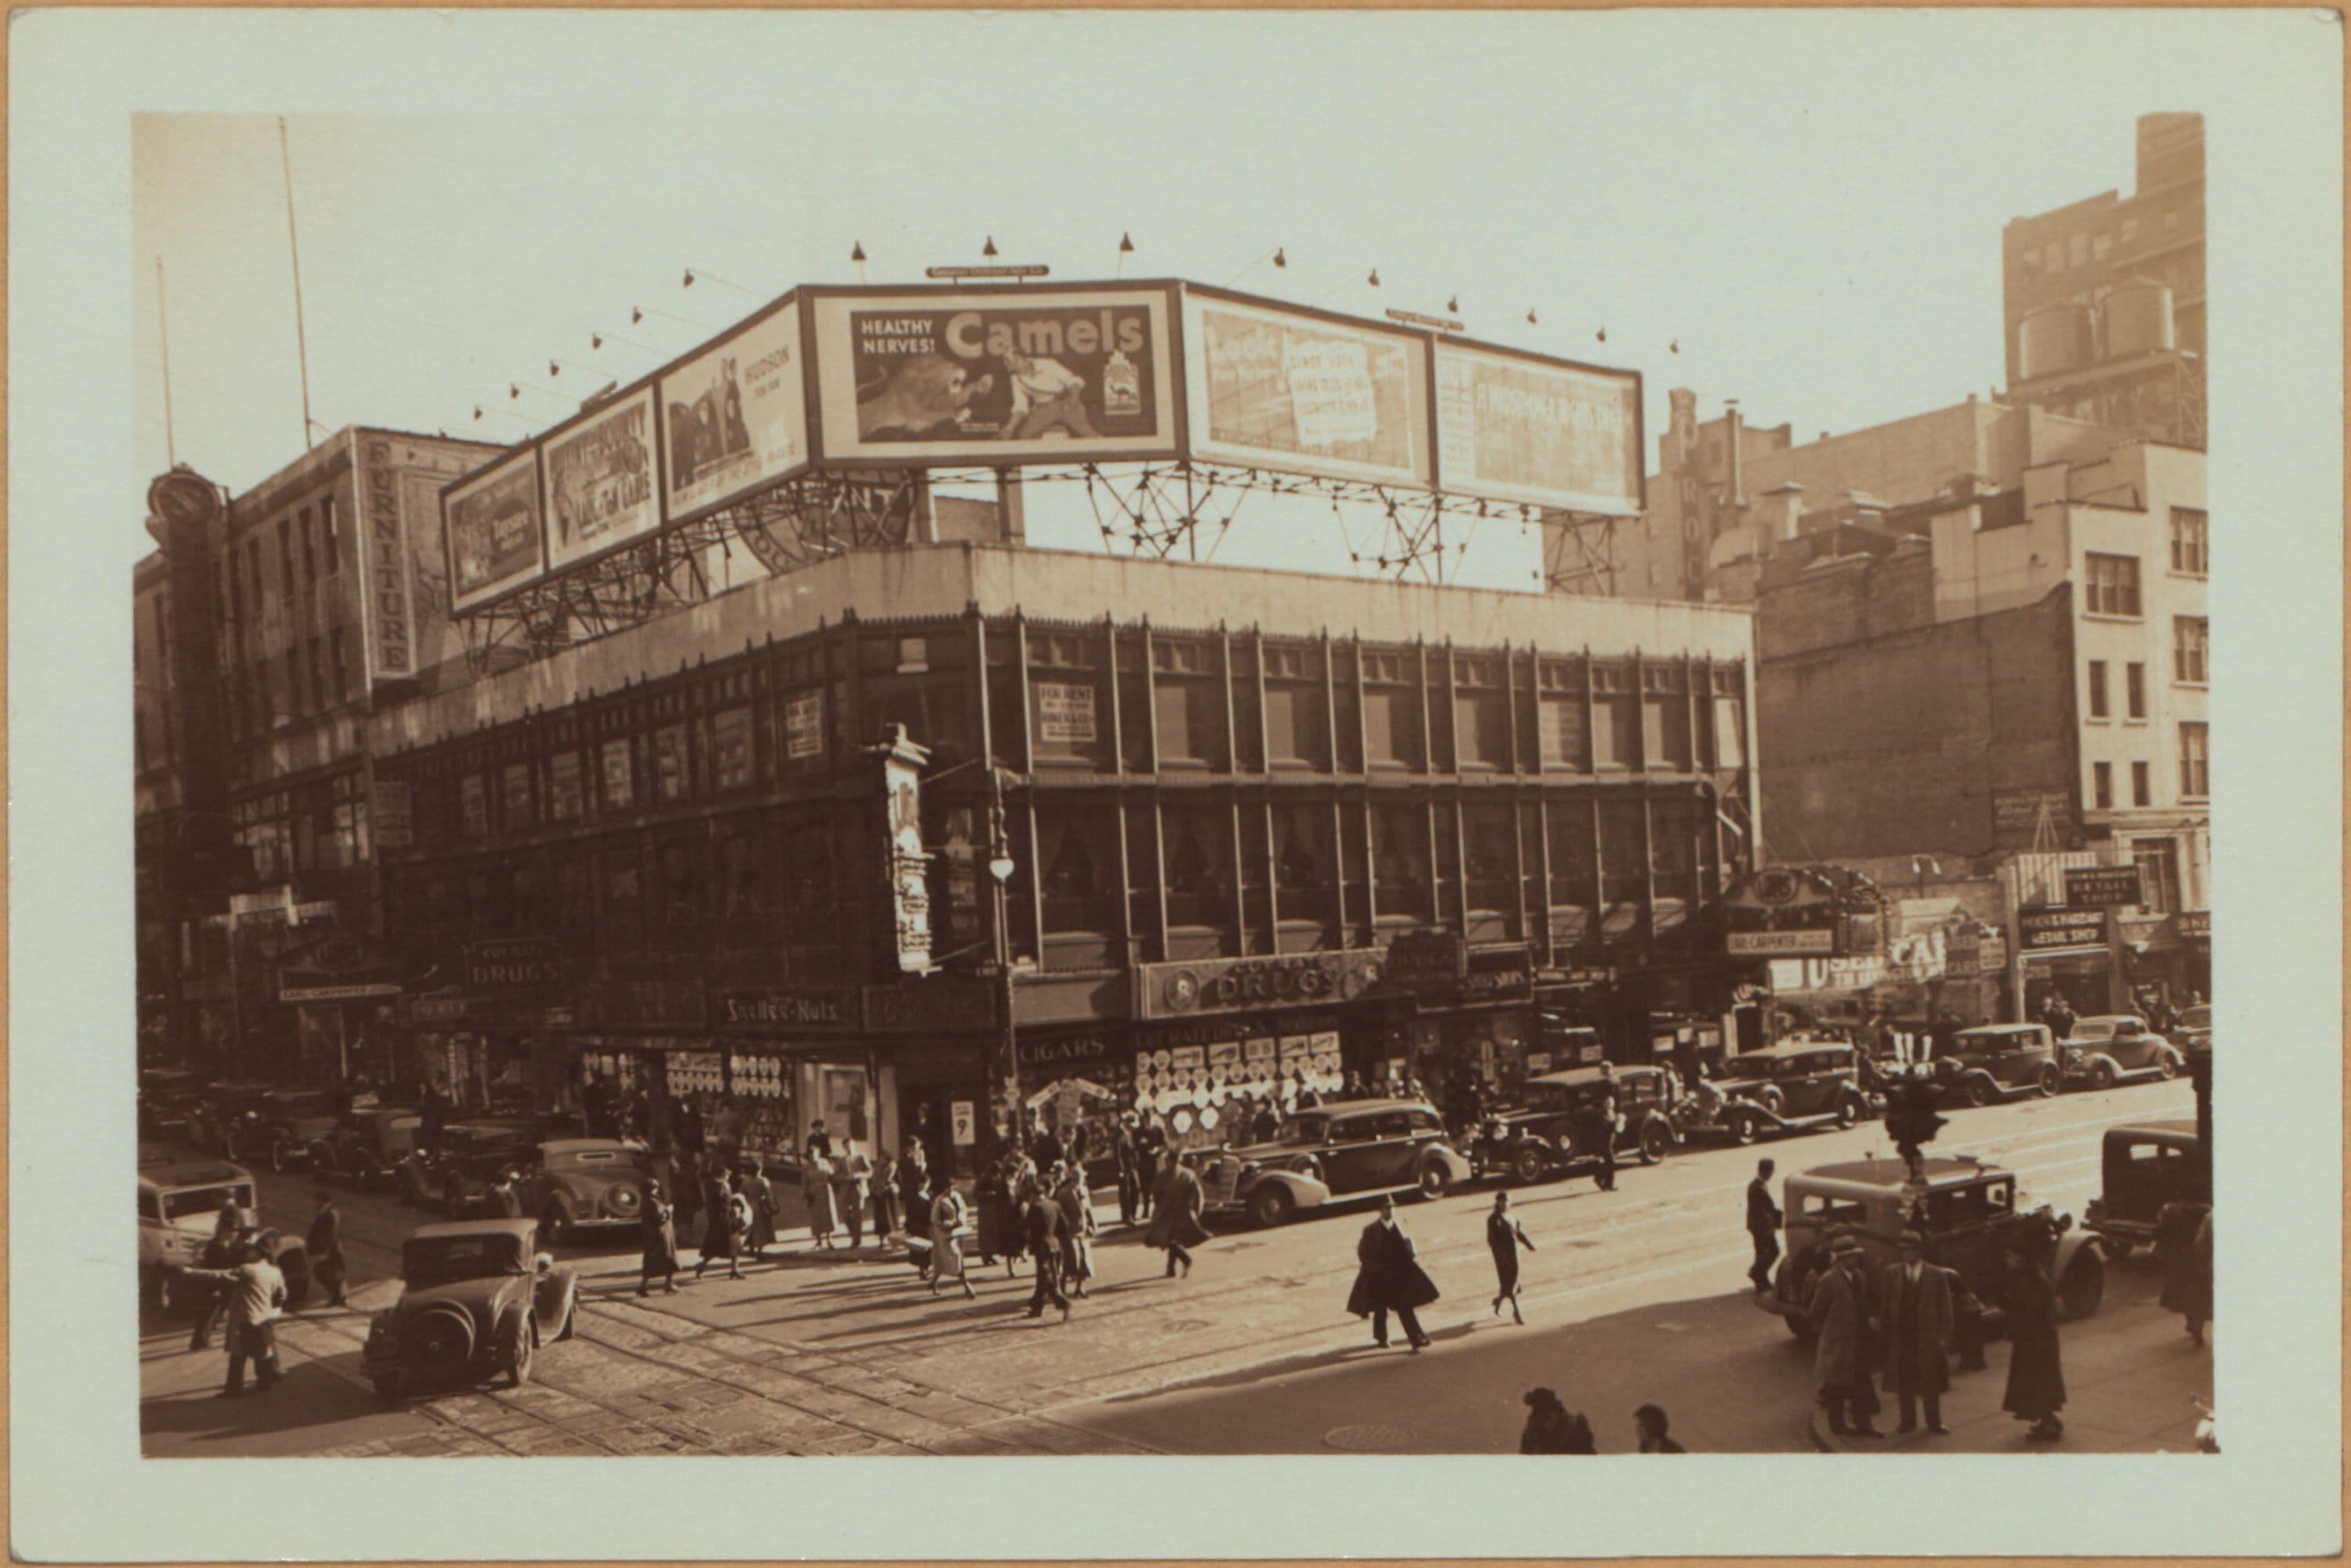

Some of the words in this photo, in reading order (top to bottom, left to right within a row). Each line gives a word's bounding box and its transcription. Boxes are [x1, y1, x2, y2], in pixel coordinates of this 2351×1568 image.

[862, 319, 933, 336] HEALTHY
[945, 309, 1145, 359] Camels
[863, 337, 935, 354] NERVES!
[744, 344, 790, 386] HUDSON
[472, 962, 559, 985] DRUGS
[1217, 968, 1336, 1001] DRUGS
[1020, 1039, 1105, 1063] CIGARS
